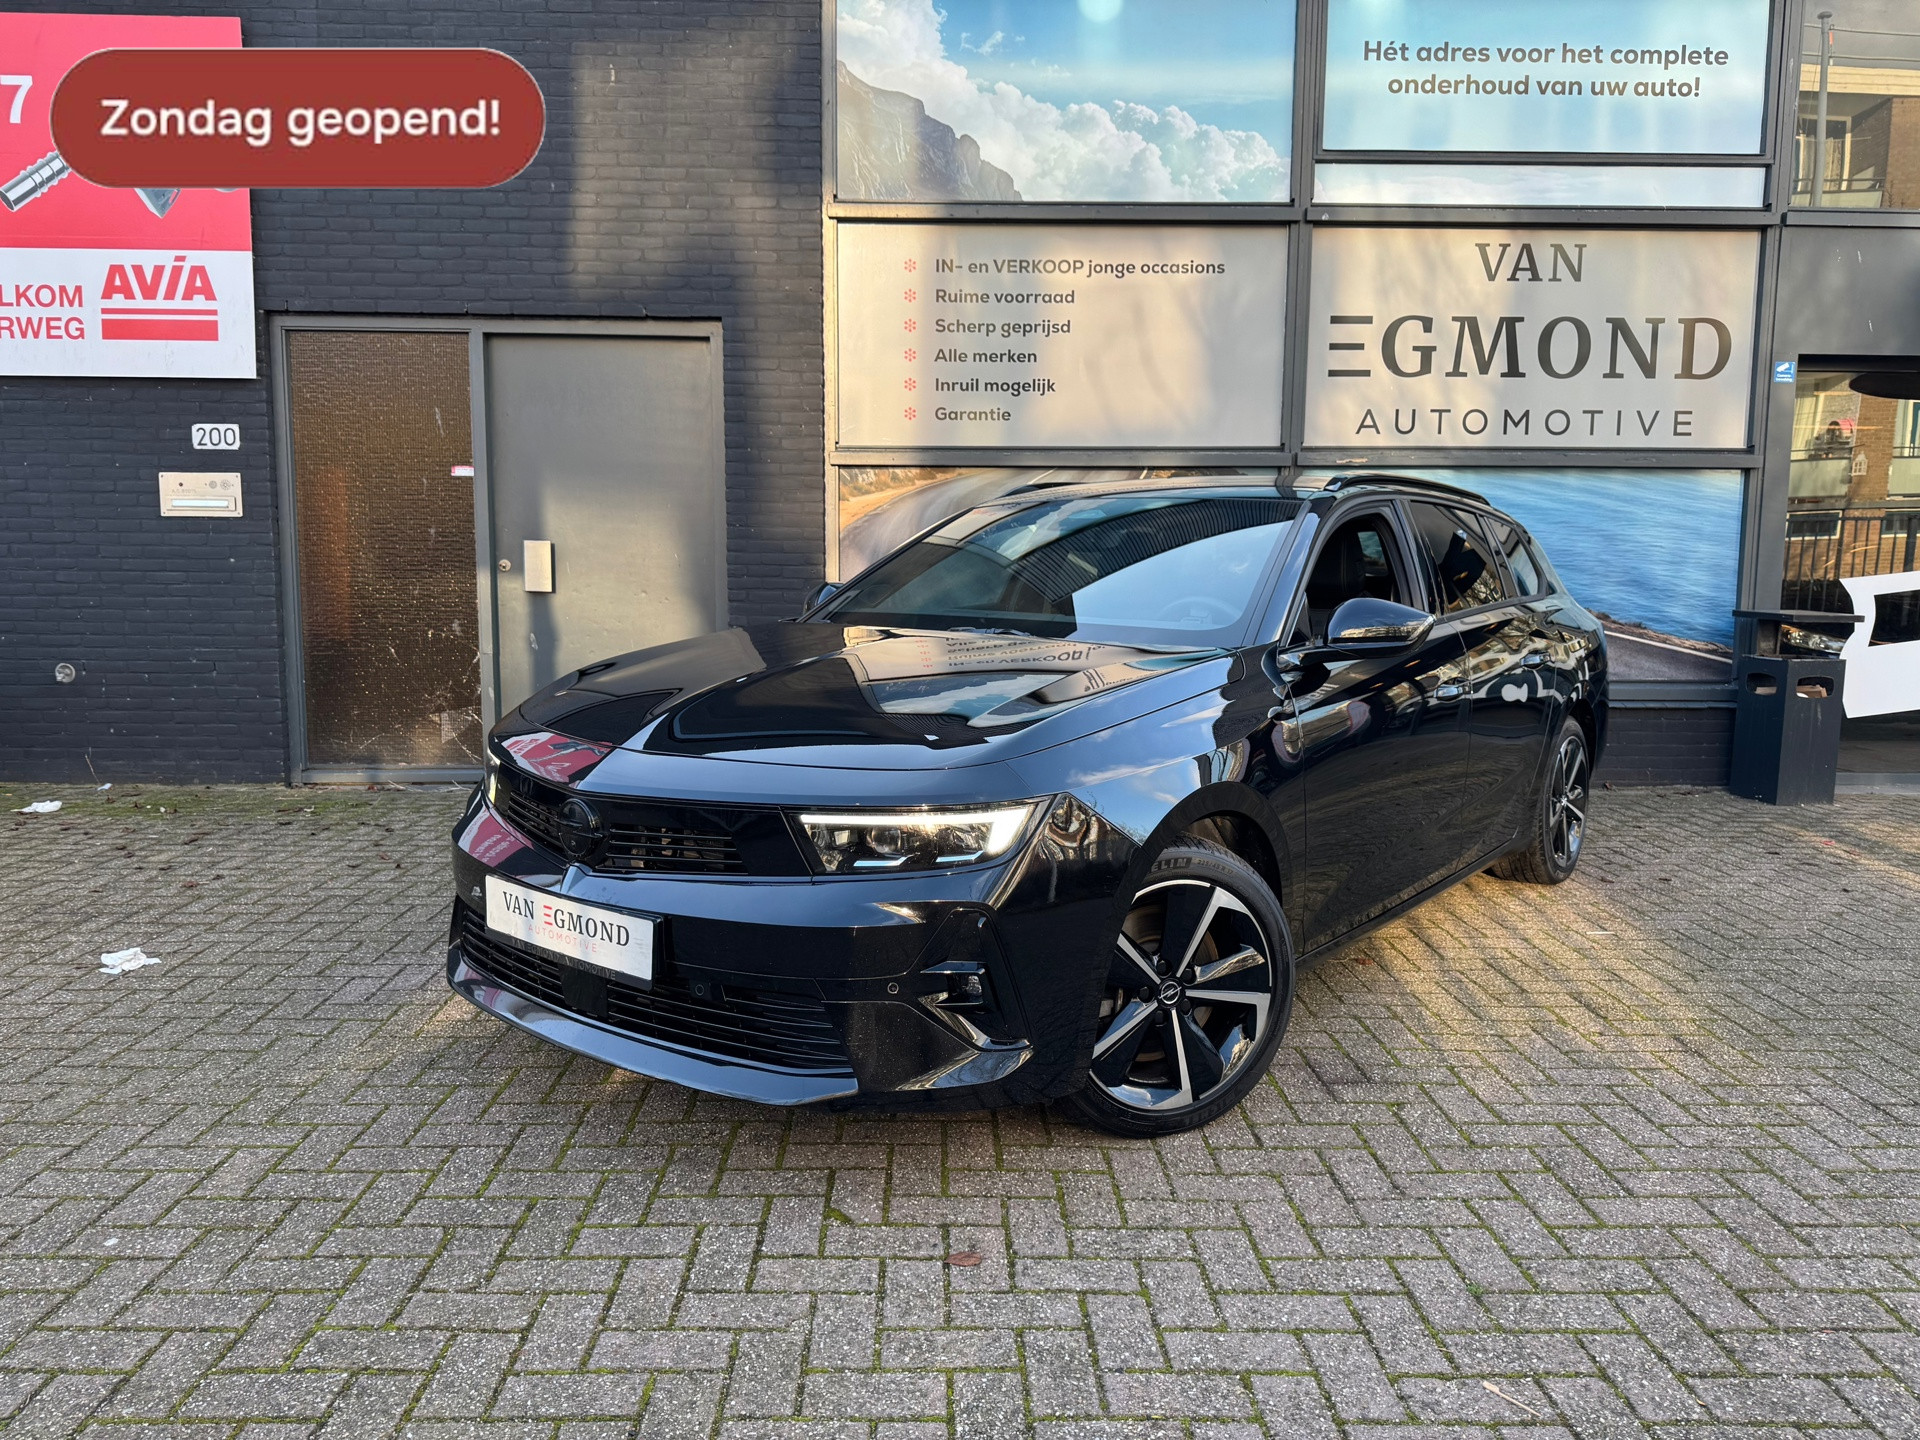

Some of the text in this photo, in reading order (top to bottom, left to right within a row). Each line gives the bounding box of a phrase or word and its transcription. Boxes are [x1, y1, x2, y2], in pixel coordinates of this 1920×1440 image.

[1364, 40, 1729, 71] Hét adres voor het complete
[1387, 73, 1701, 98] onderhoud van uw auto!
[935, 258, 1226, 280] IN- en VERKOOP jonge occasions
[1474, 242, 1588, 283] VAN
[935, 288, 1076, 304] Ruime voorraad
[935, 318, 1071, 339] Scherp geprijsd
[934, 348, 1037, 364] Alle merken
[1327, 314, 1732, 381] EGMOND
[935, 377, 1056, 398] Inruil mogelijk
[935, 406, 1012, 422] Garantie
[1355, 408, 1694, 437] AUTOMOTIVE
[196, 427, 236, 446] 200
[502, 891, 630, 947] VAN EGMOND
[528, 924, 599, 953] AUTOMOTIVE
